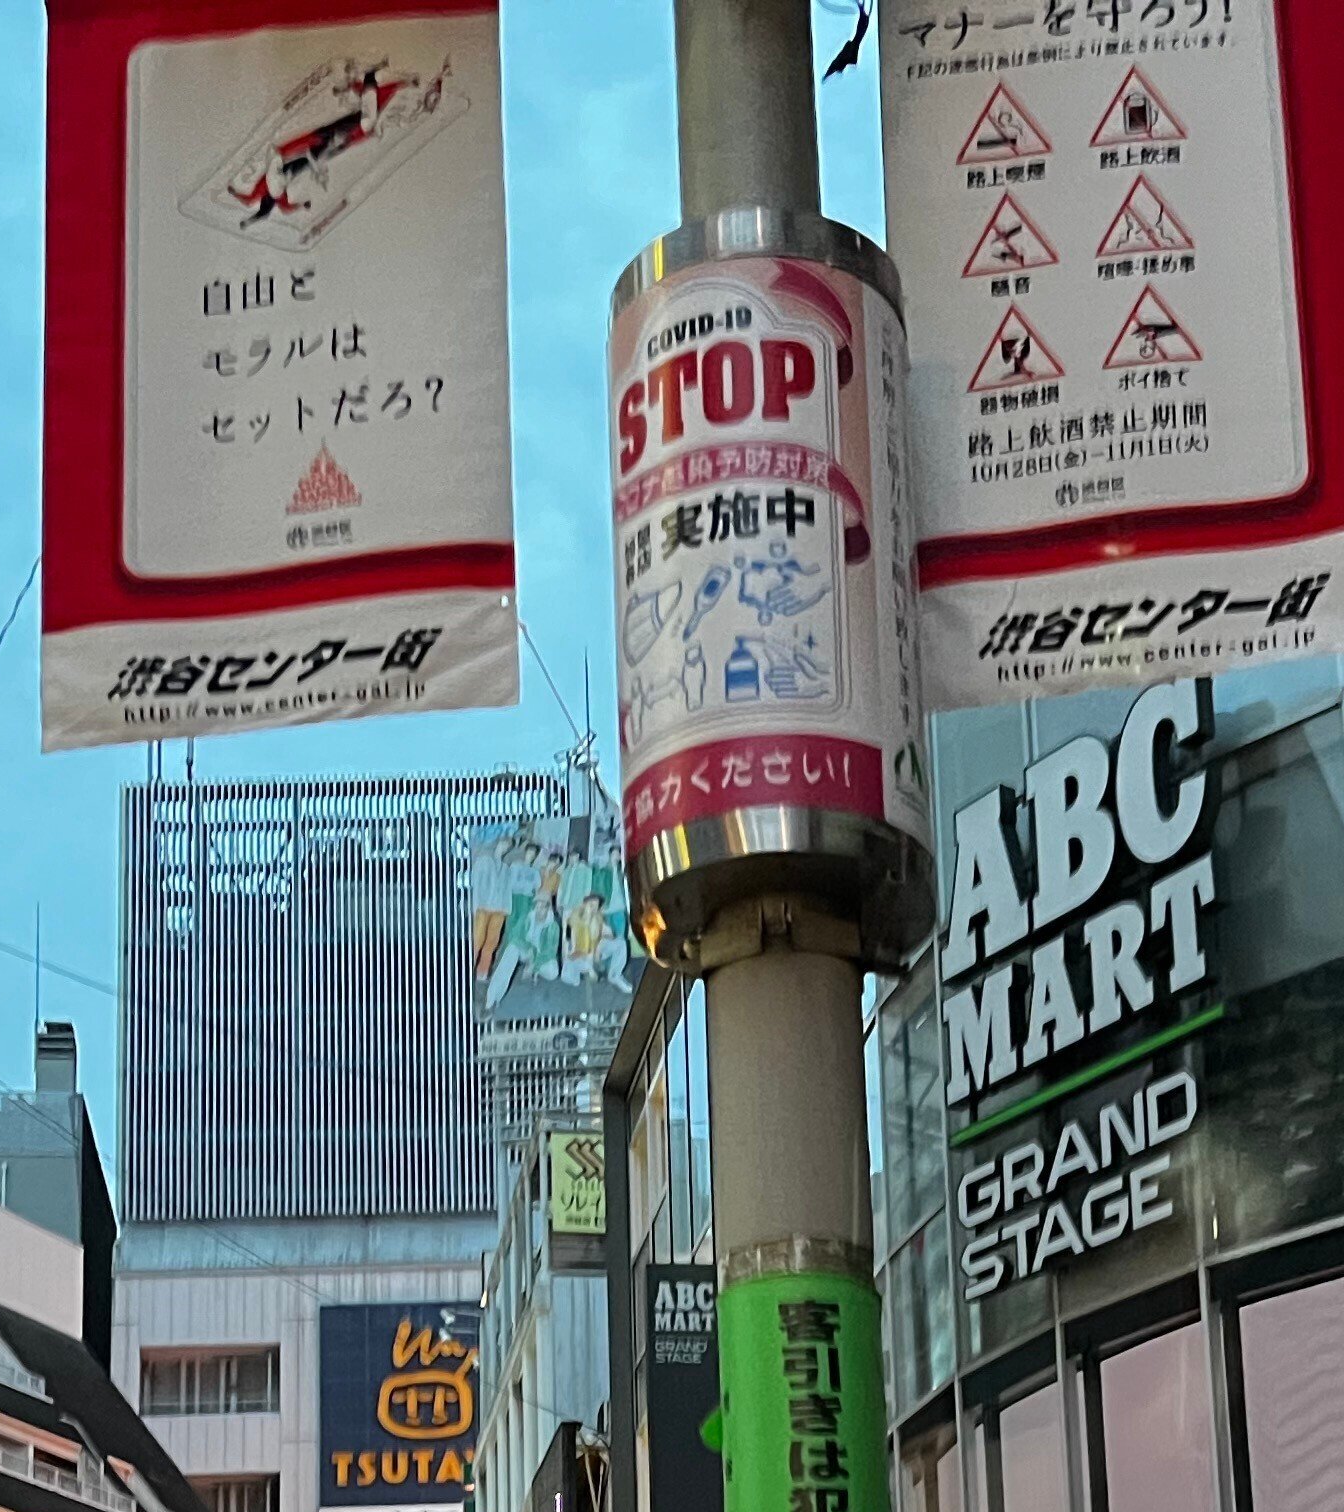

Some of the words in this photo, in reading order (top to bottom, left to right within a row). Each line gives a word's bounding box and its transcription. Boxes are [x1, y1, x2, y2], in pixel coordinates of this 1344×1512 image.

[203, 271, 316, 317] 自由と
[201, 323, 368, 378] モラルは
[201, 374, 444, 444] セットだろ?
[619, 339, 816, 476] STOP
[968, 400, 1207, 459] 路上飲酒禁止期間
[661, 487, 816, 562] 実施中
[979, 571, 1331, 660] 渋谷センター街
[107, 627, 443, 701] 渋谷センター街
[942, 677, 1213, 983] ABC
[942, 851, 1216, 1106] MART
[958, 1071, 1198, 1229] GRAND
[961, 1155, 1173, 1301] STAGE
[654, 1280, 714, 1311] ABC
[654, 1312, 715, 1333] MART
[654, 1340, 708, 1354] GRAND
[656, 1353, 703, 1365] STAGE
[331, 1449, 475, 1488] TSUTA
